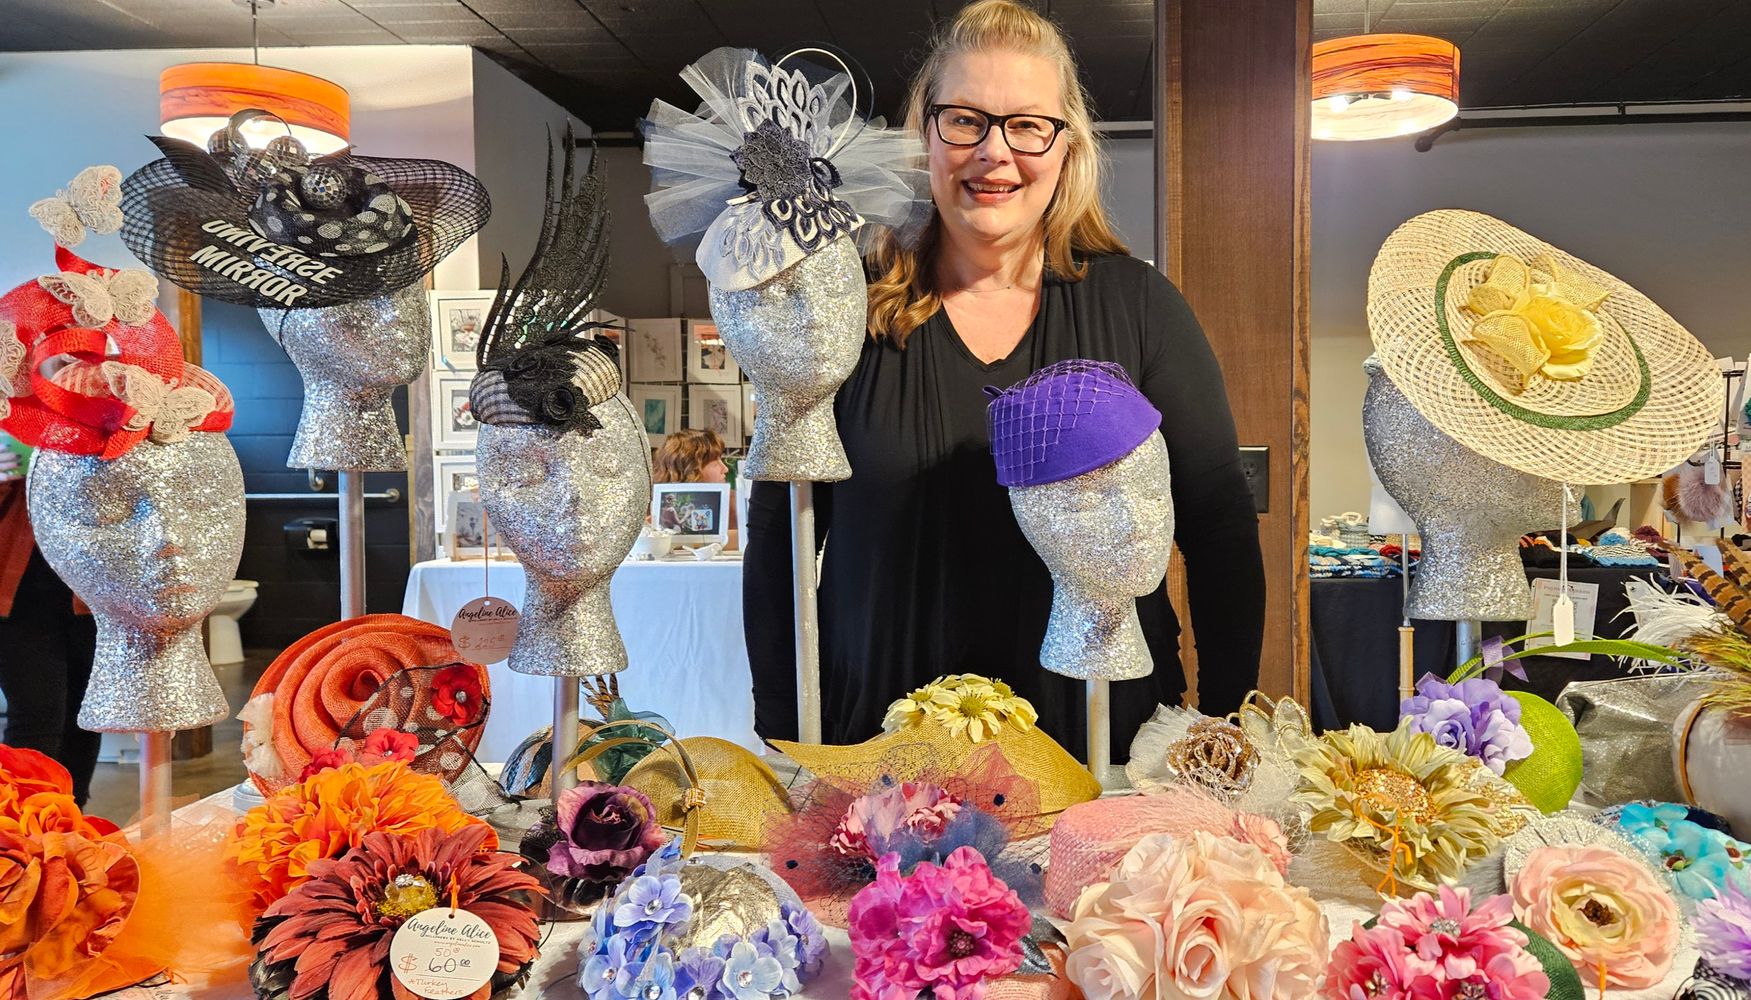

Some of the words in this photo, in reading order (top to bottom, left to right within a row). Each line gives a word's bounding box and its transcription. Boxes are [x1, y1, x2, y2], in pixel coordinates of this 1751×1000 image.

[189, 245, 308, 307] MIRROR
[458, 607, 493, 622] Angeline
[495, 606, 517, 618] Alice
[407, 918, 459, 937] Angeline
[461, 924, 492, 939] Alice
